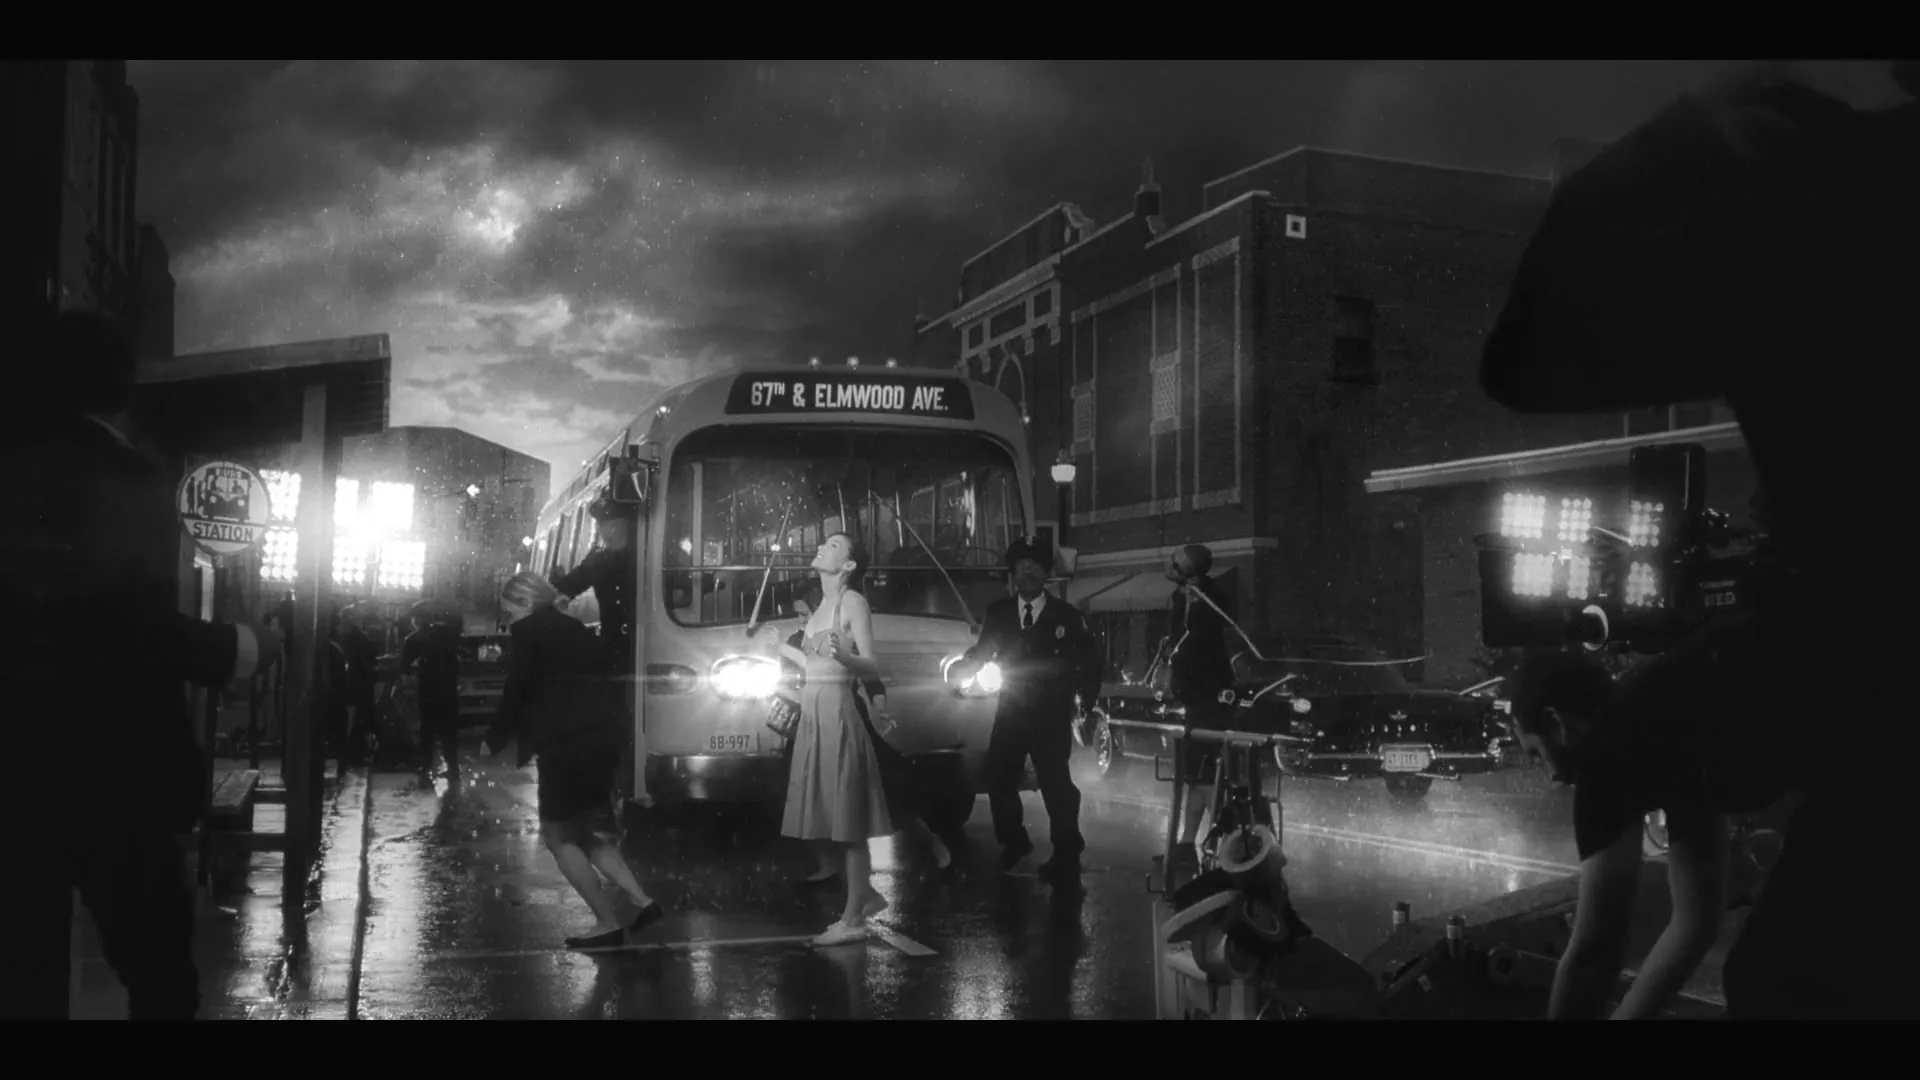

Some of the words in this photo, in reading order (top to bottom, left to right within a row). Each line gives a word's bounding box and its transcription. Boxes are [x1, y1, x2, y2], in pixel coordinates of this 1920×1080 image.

[793, 383, 806, 407] &
[815, 383, 904, 409] ELMWOOD
[912, 386, 949, 411] AVE.
[194, 522, 253, 542] STATION
